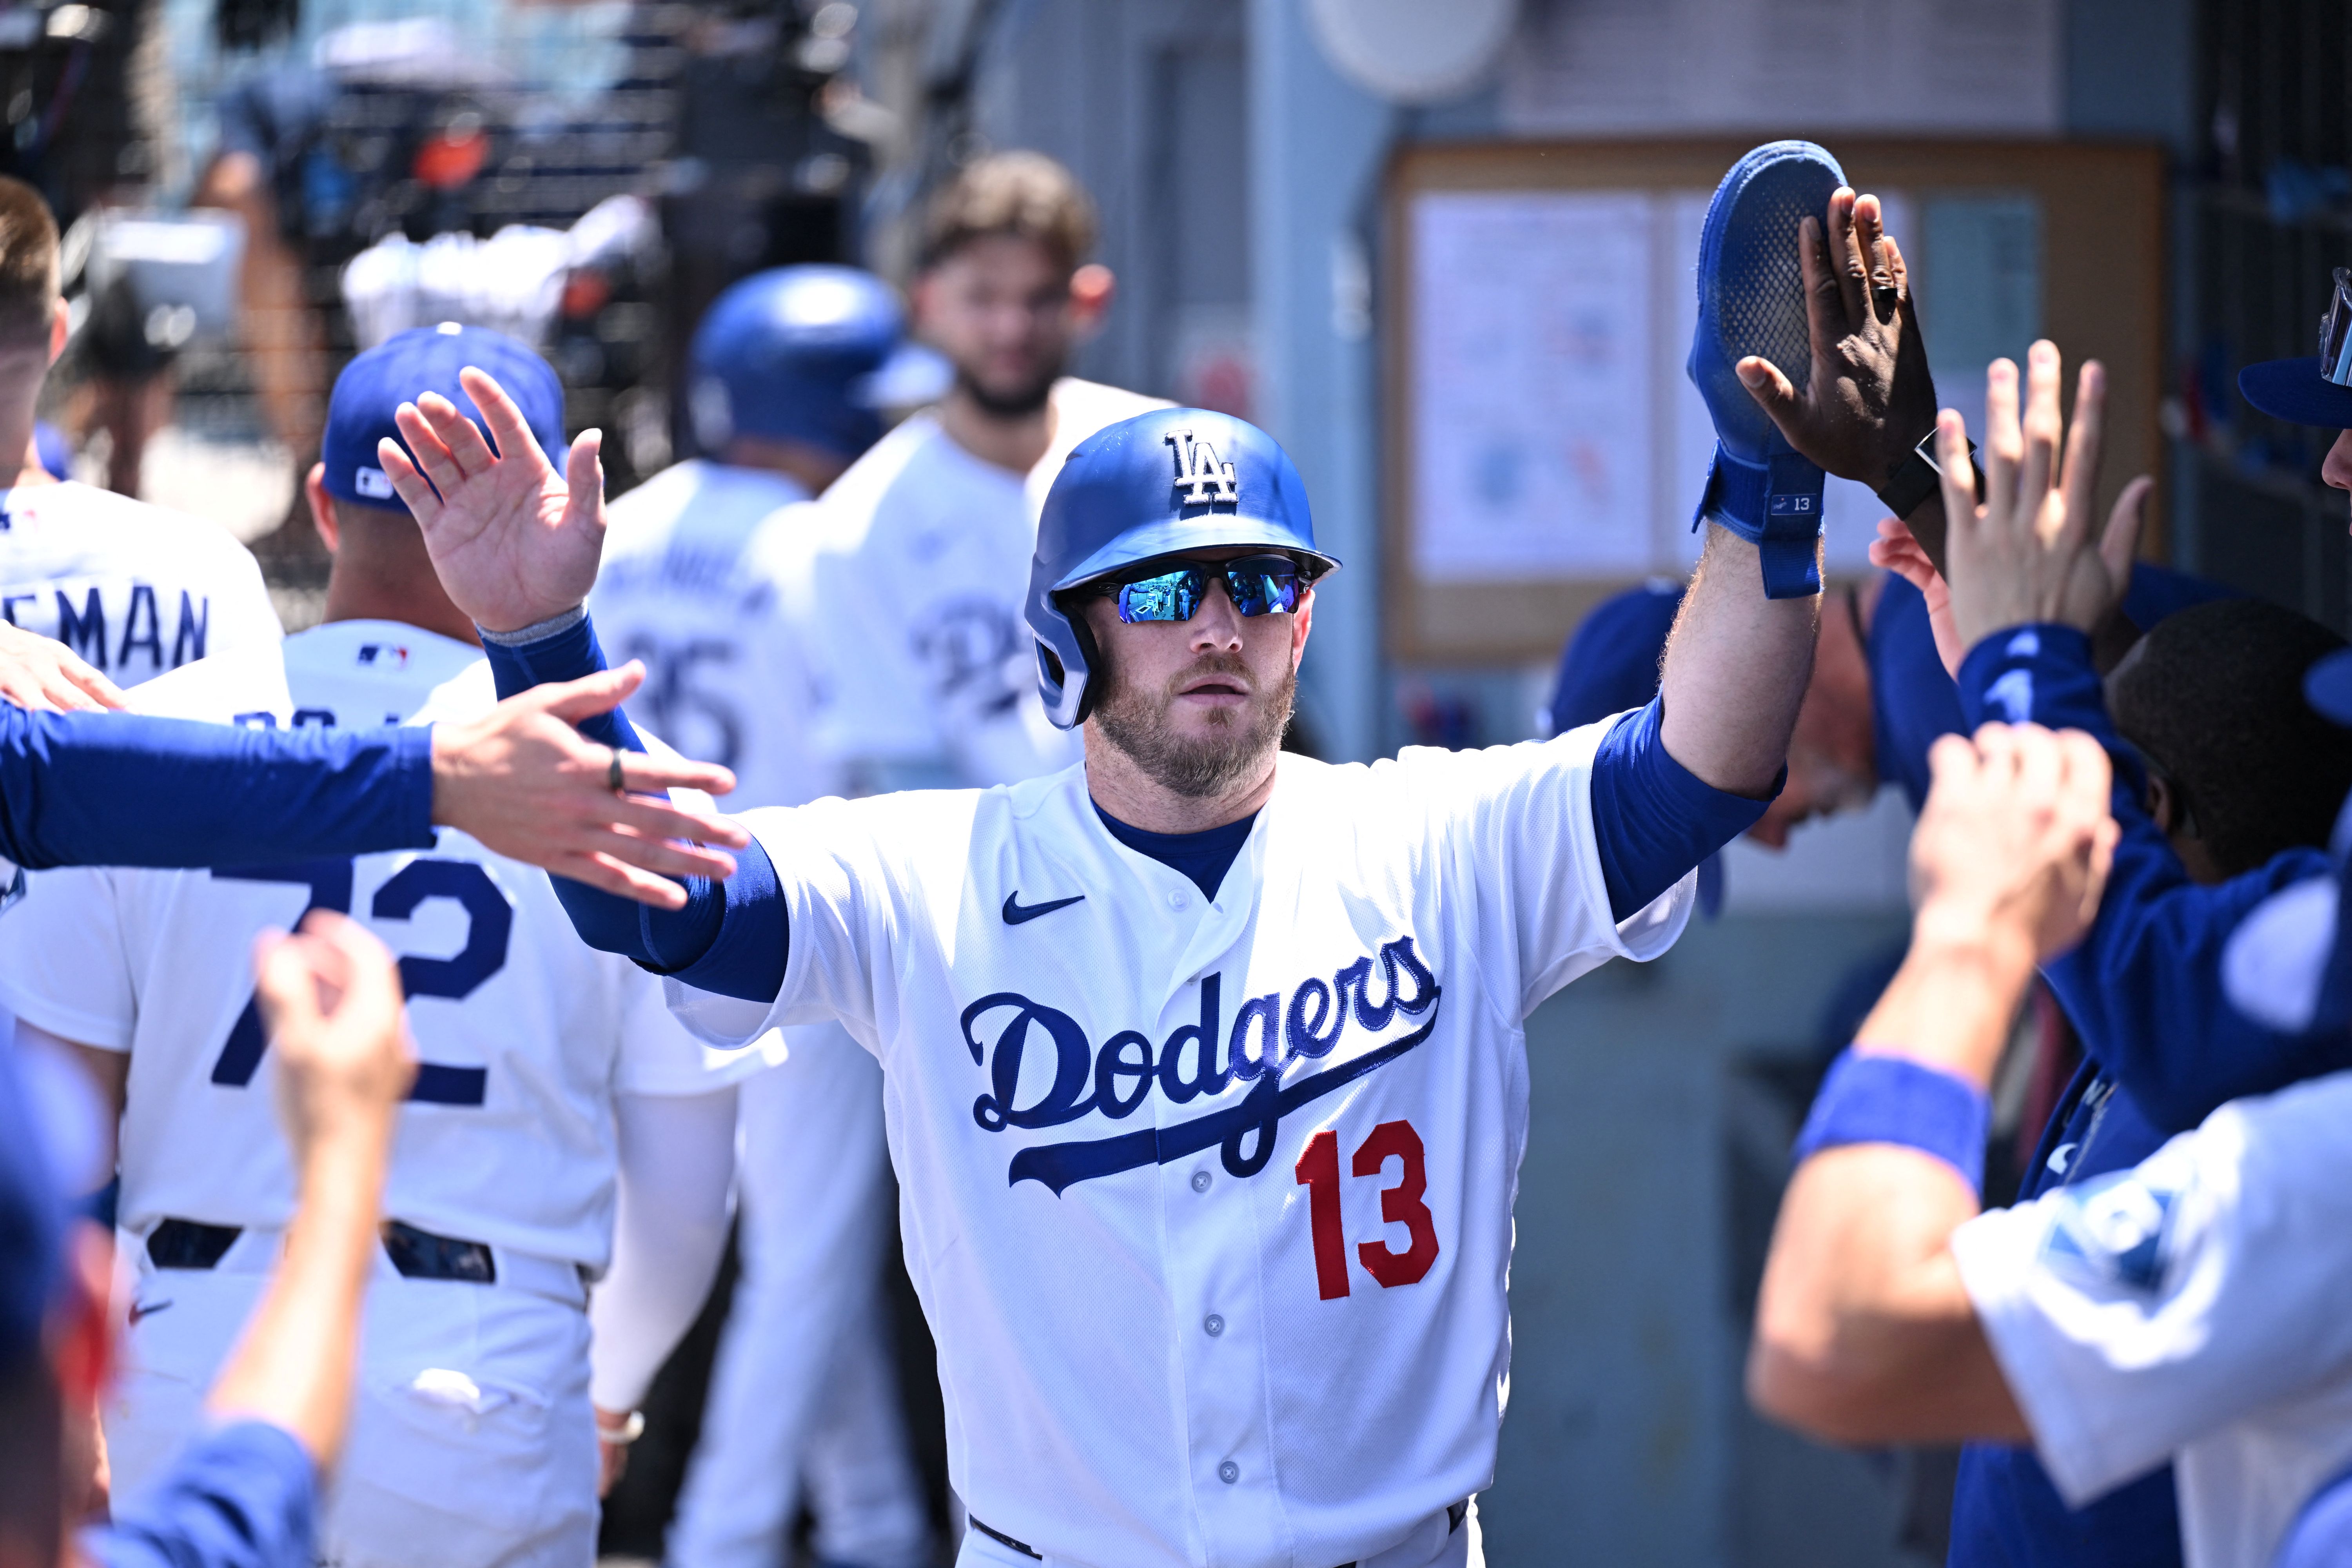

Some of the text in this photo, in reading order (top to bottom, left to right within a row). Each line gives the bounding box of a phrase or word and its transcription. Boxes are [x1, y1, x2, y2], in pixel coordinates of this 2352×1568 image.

[1164, 429, 1238, 506] LA
[1795, 497, 1810, 510] 13
[211, 856, 513, 1107] 72
[961, 935, 1441, 1178] Dodgers
[1295, 1120, 1439, 1300] 13
